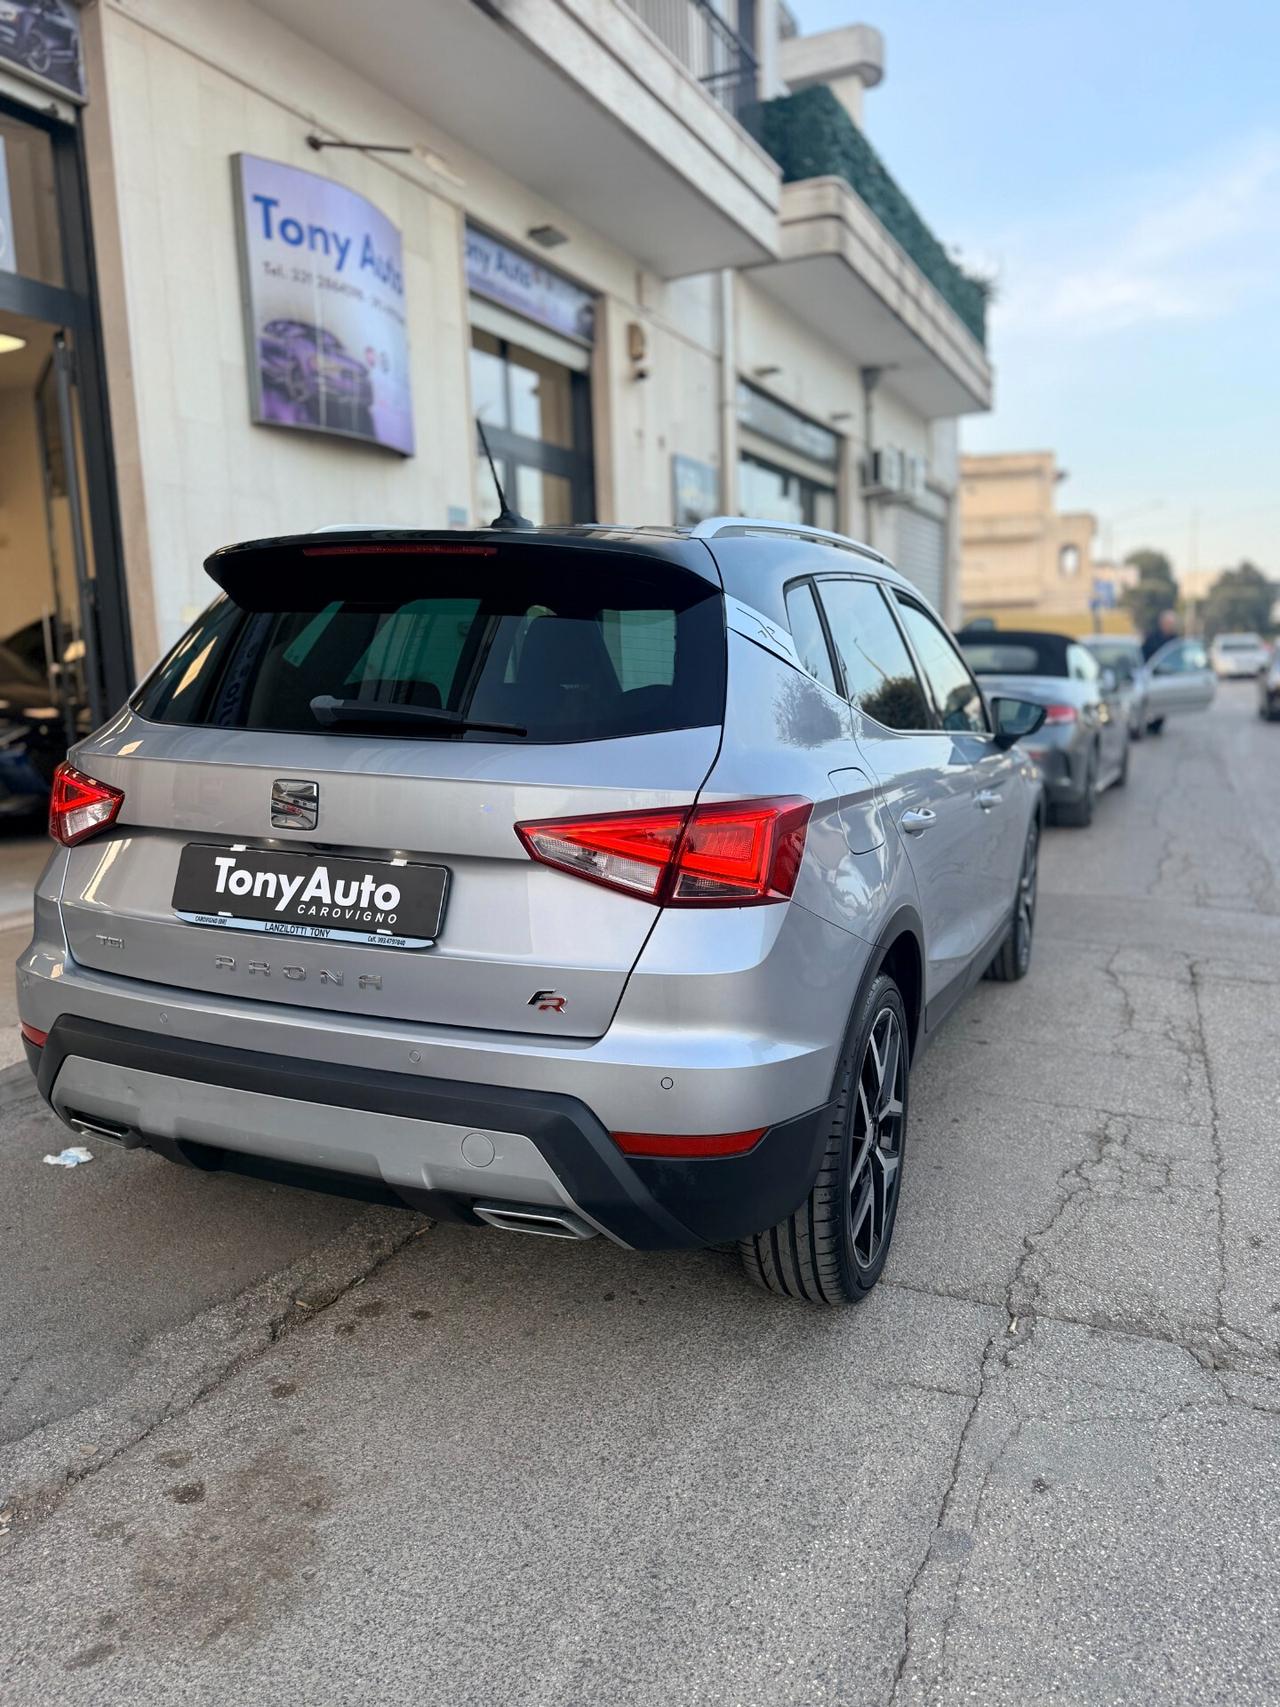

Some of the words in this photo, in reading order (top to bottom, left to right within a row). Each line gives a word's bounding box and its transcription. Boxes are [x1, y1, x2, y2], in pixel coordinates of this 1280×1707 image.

[253, 194, 351, 272] Tony
[215, 857, 401, 911] TonyAuto
[297, 905, 397, 924] CAROVIGNO
[264, 922, 308, 935] LANZILOTTI
[310, 927, 331, 938] TONY
[215, 954, 383, 990] ARONA
[526, 988, 567, 1013] FR
